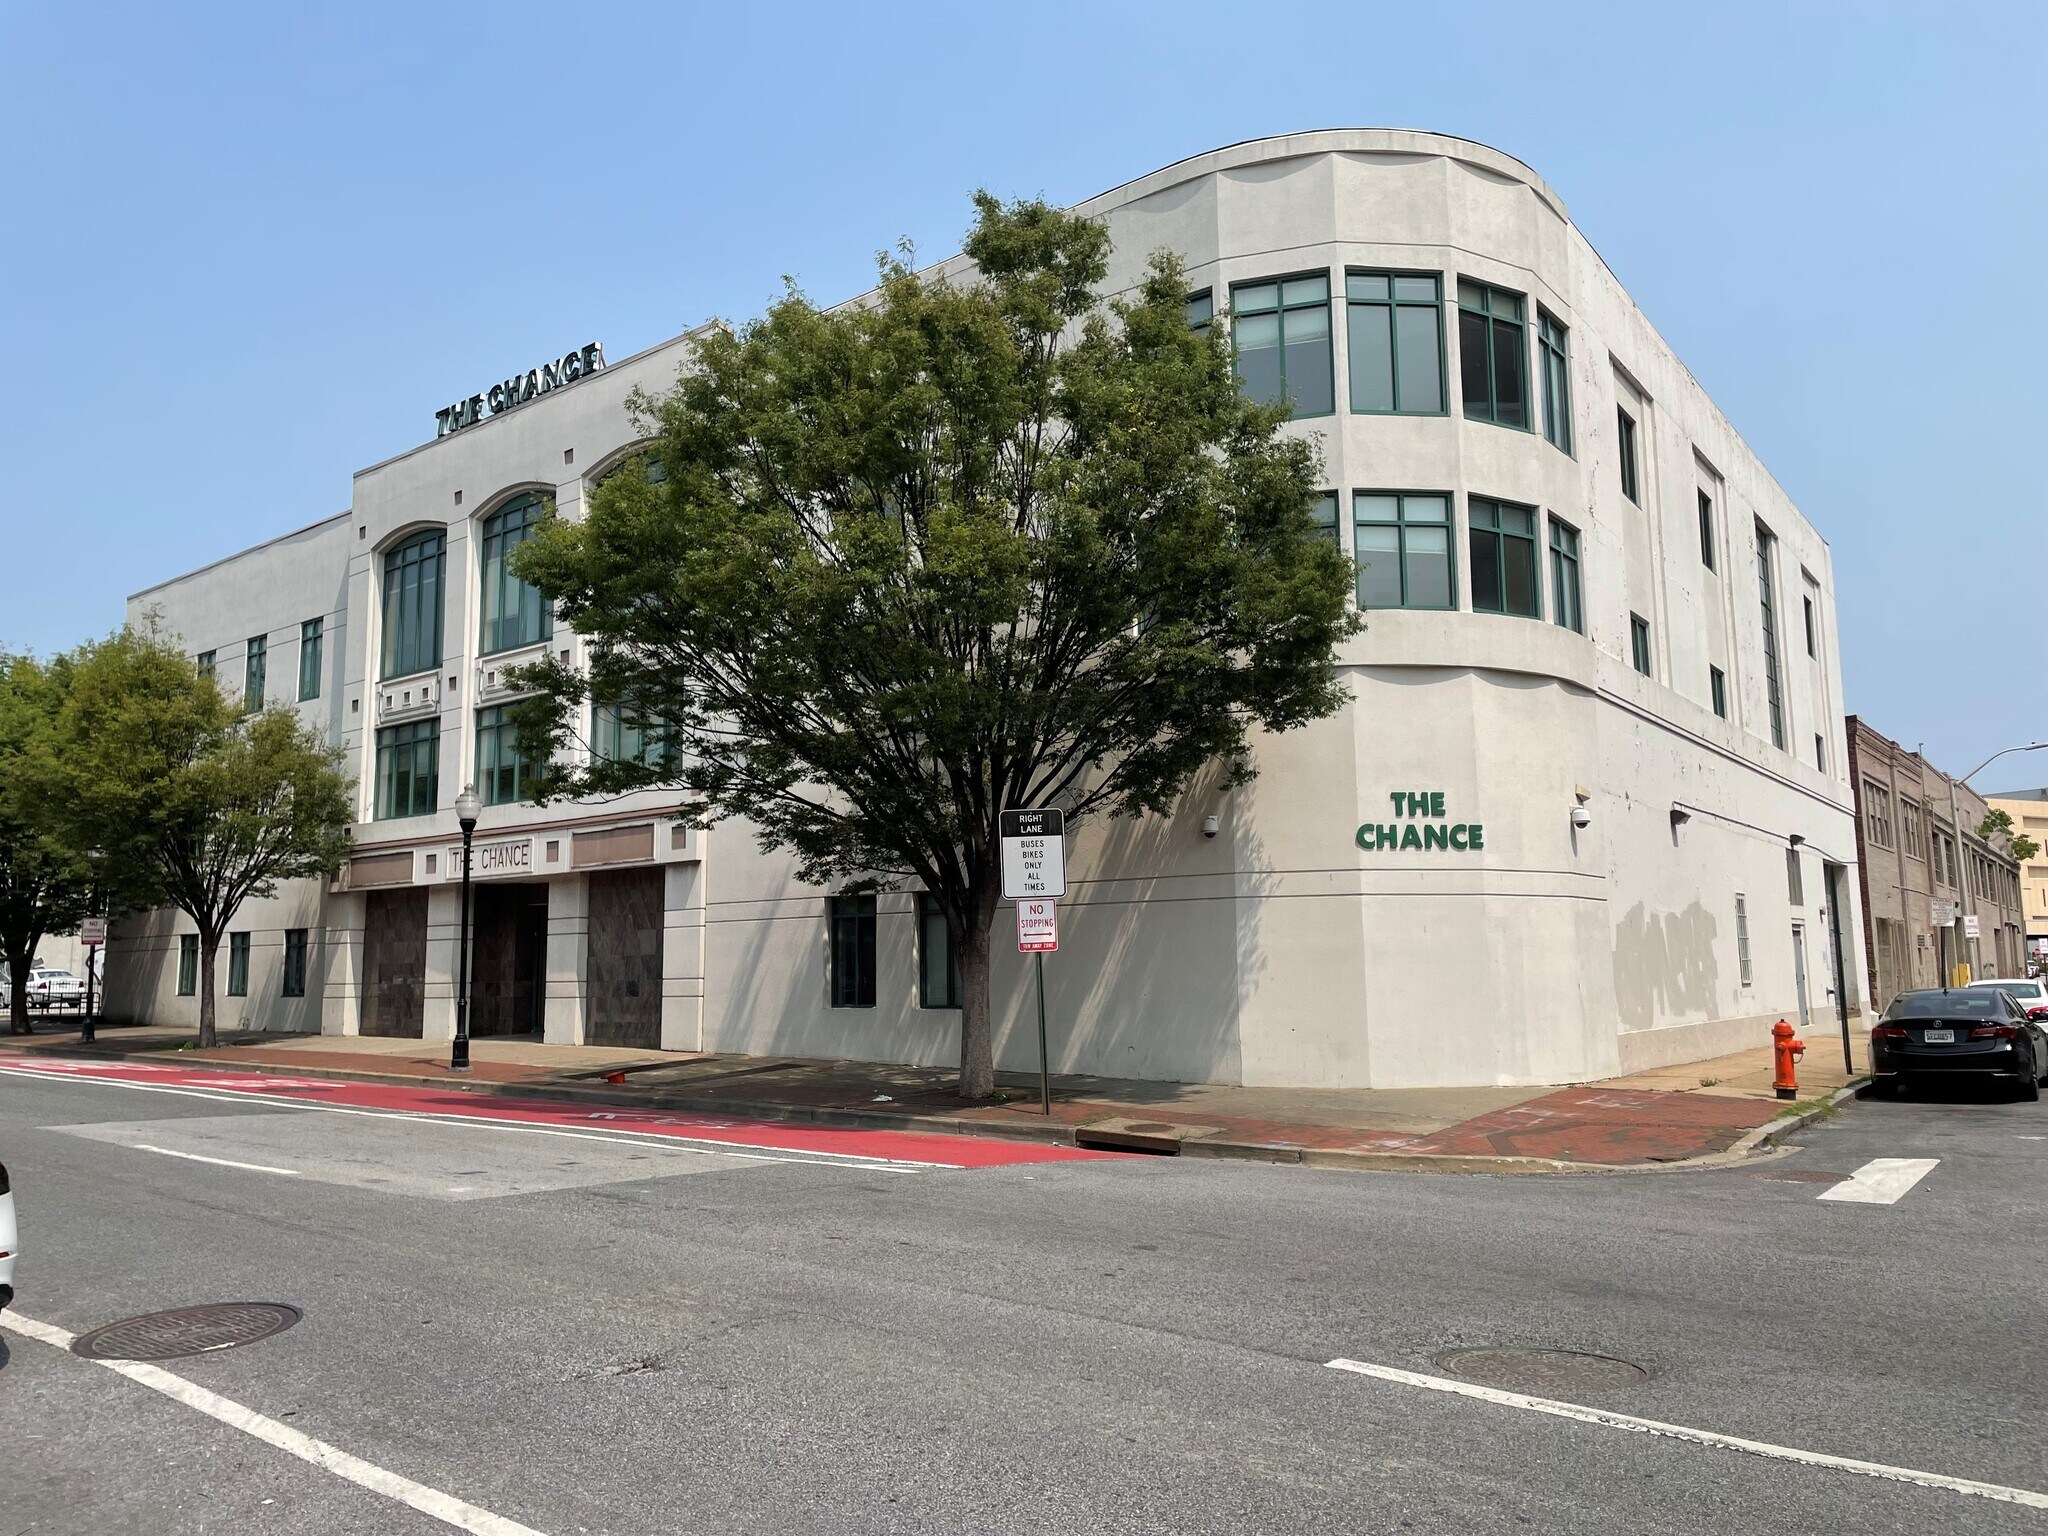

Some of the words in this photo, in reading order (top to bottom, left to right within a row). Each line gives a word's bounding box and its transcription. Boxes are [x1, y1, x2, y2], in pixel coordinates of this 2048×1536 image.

[435, 392, 486, 438] THE
[487, 341, 602, 414] CHANCE
[1390, 792, 1446, 817] THE
[1019, 814, 1043, 823] RIGHT
[1020, 825, 1043, 834] LANE
[1355, 824, 1484, 850] CHANCE
[1020, 840, 1045, 848] BUSES
[482, 844, 529, 869] CHANCE
[1022, 851, 1044, 859] BIKES
[1024, 861, 1042, 870] ONLY
[1027, 872, 1041, 880] ALL
[1024, 883, 1045, 891] TIMES
[1029, 904, 1044, 915] NO
[1021, 918, 1054, 928] STOPPING
